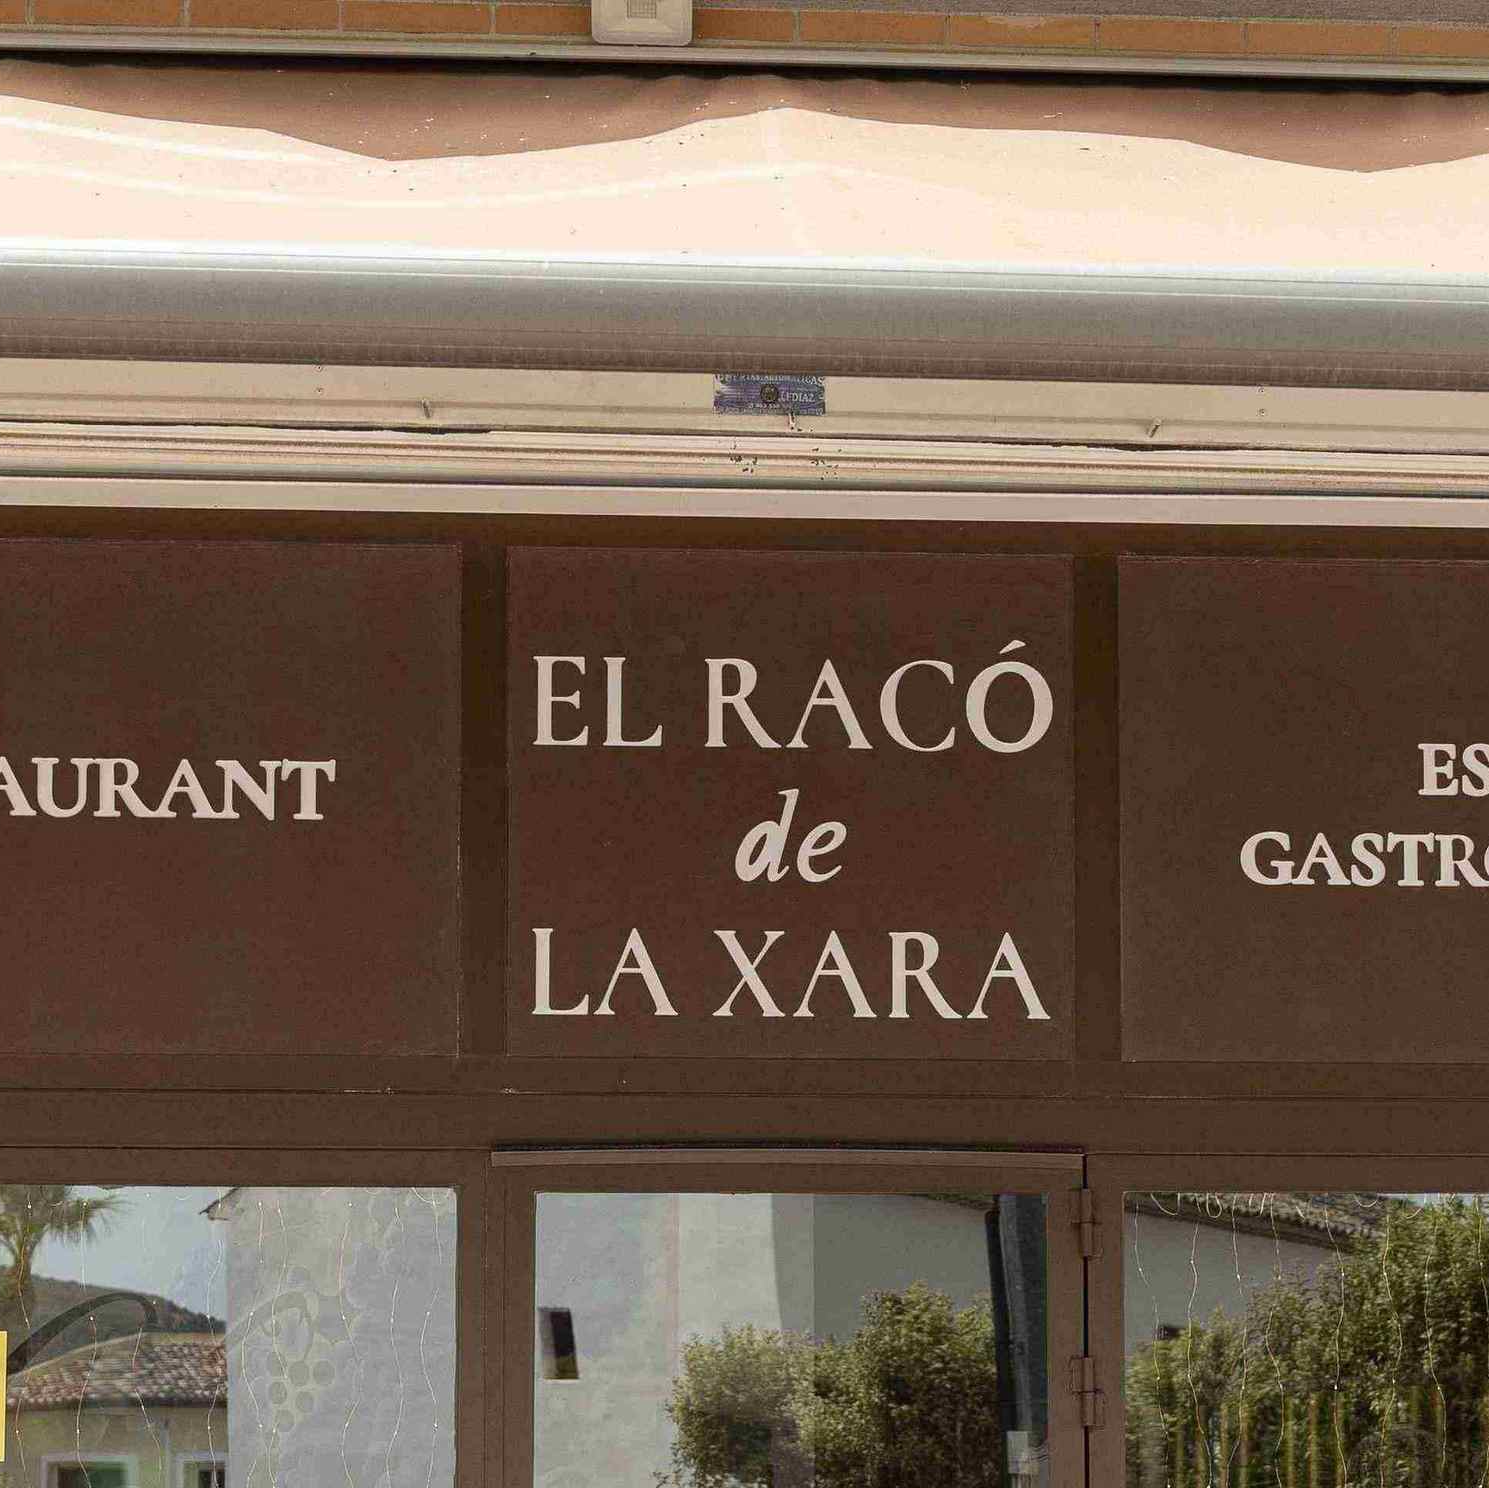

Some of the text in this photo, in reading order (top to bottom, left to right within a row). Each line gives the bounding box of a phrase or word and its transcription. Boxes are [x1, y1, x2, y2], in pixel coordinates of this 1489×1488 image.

[531, 639, 1054, 755] EL RACÓ
[734, 790, 848, 884] de
[531, 929, 1052, 1021] LA XARA
